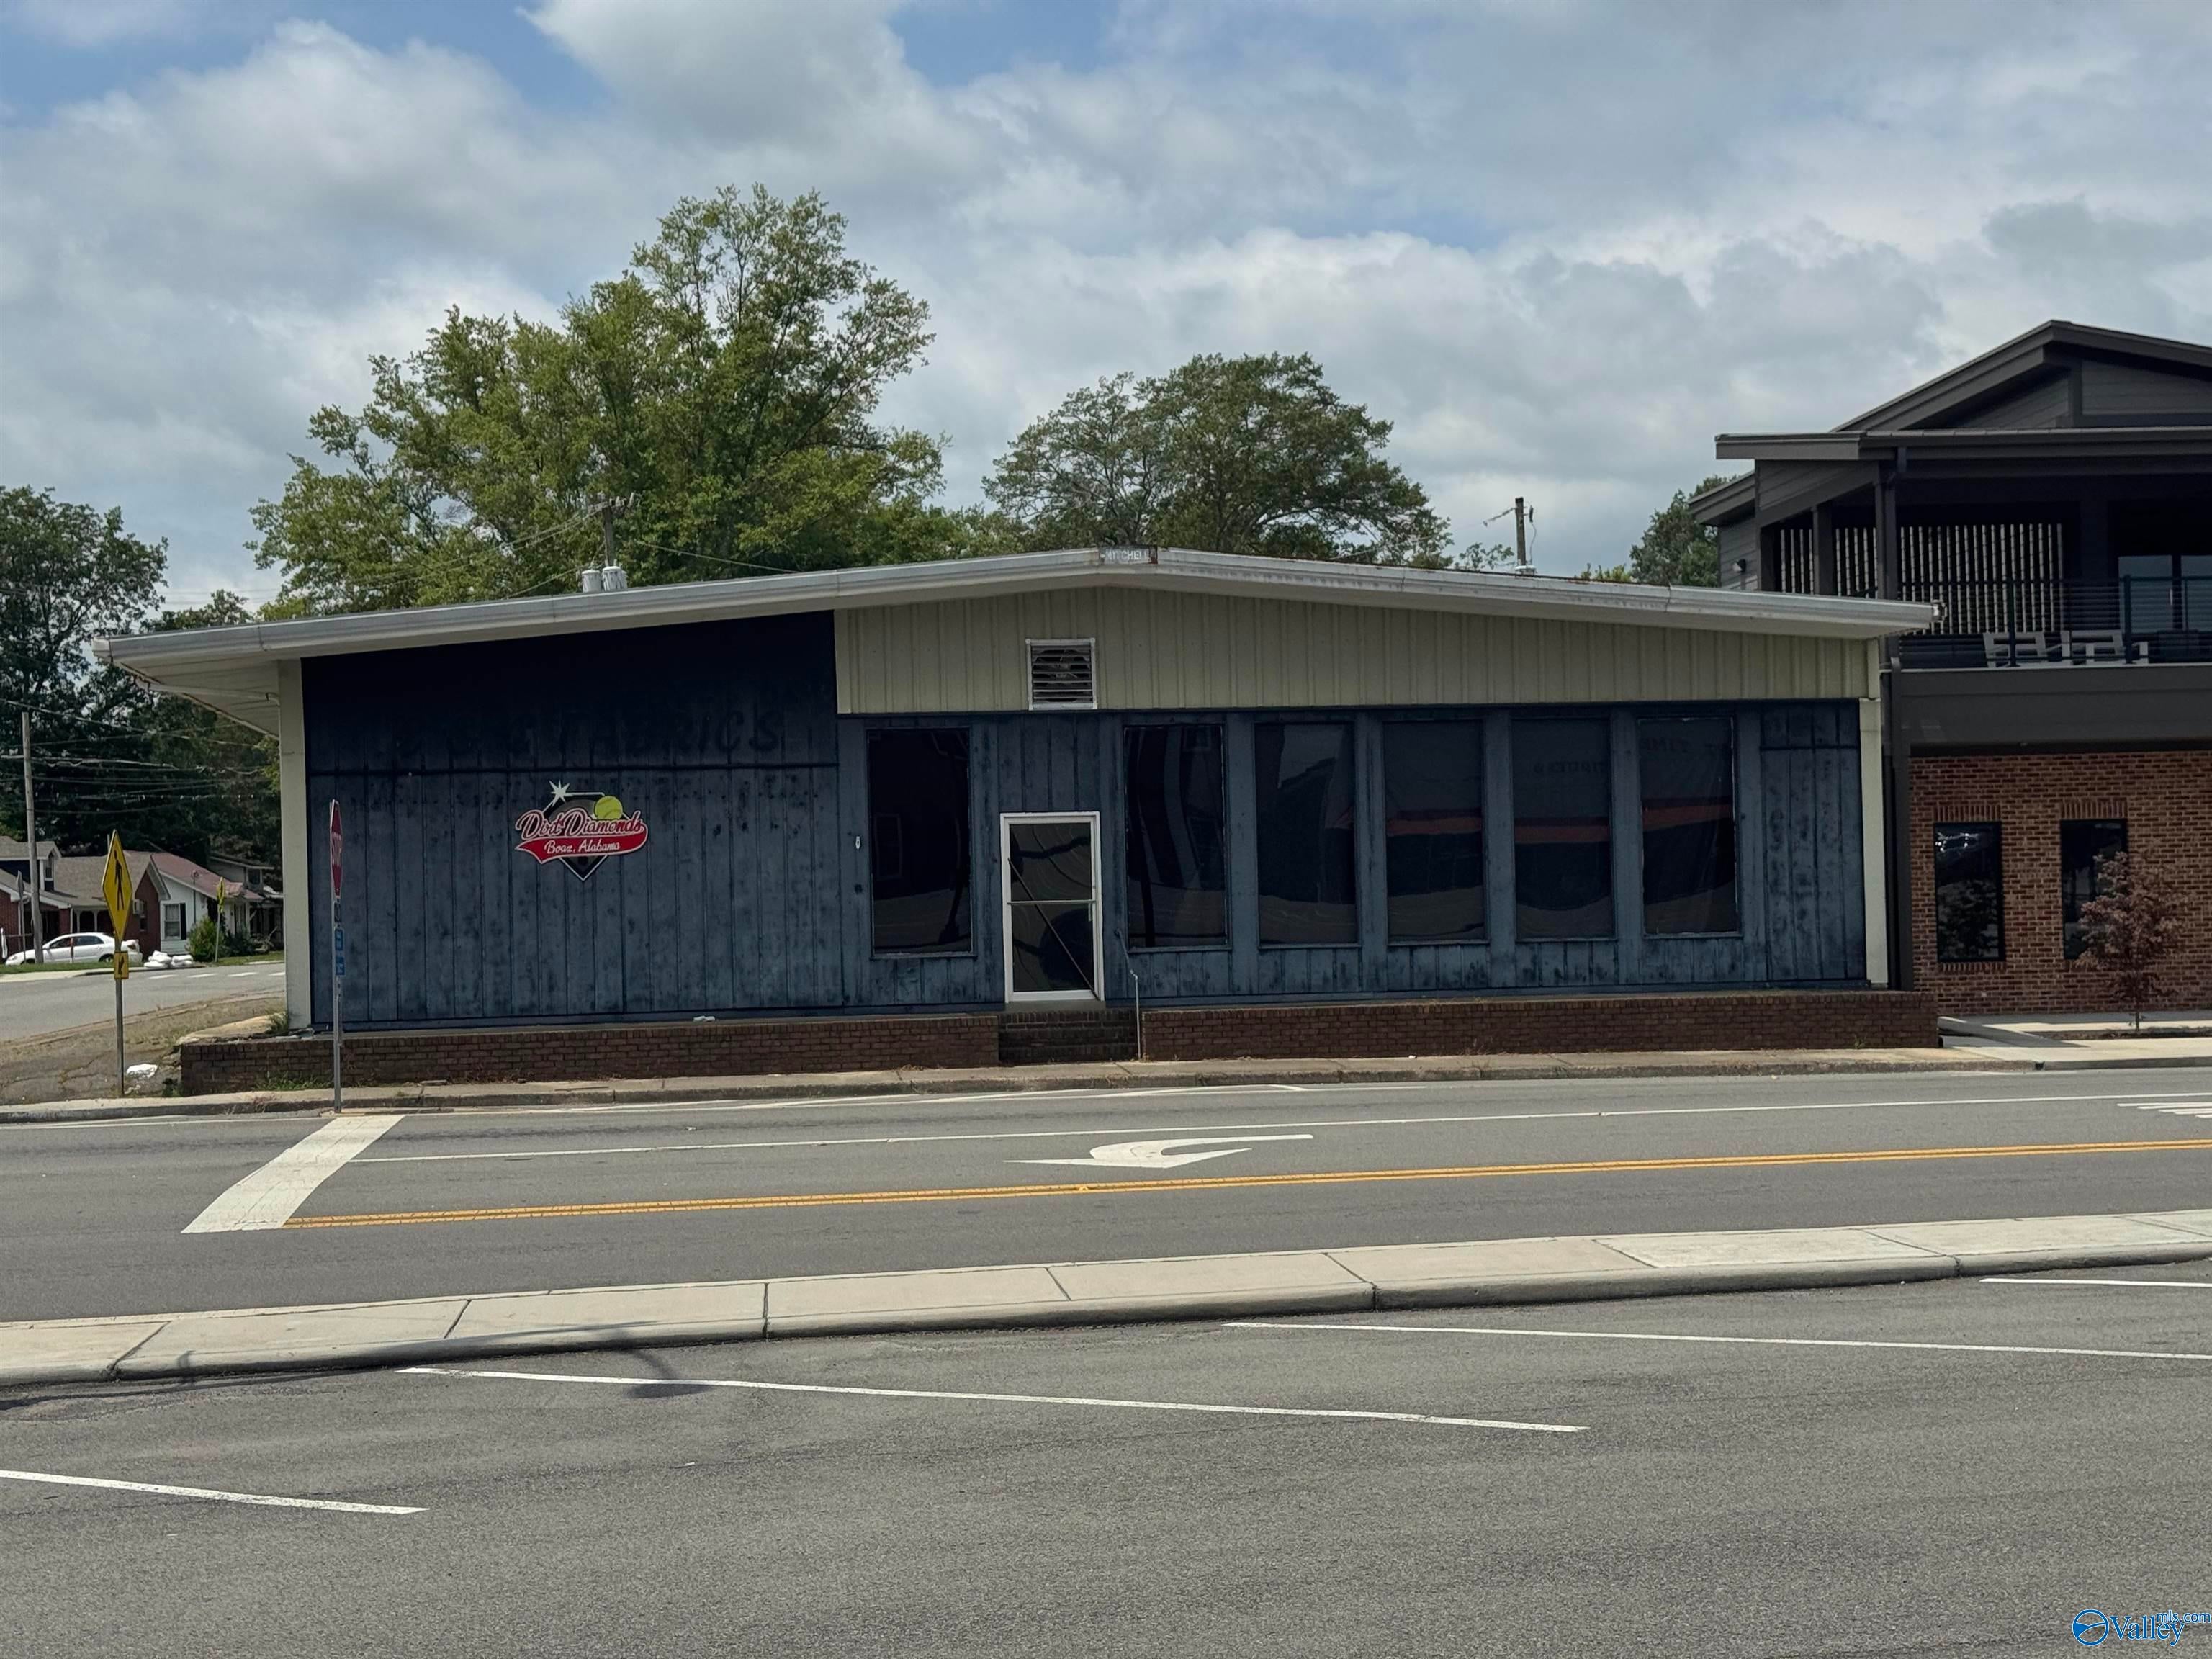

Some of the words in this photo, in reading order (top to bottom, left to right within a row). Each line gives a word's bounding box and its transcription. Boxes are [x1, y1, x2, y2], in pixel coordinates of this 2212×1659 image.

[515, 809, 565, 840] Dirt
[561, 807, 645, 837] Diamonds
[578, 839, 620, 853] Alabama
